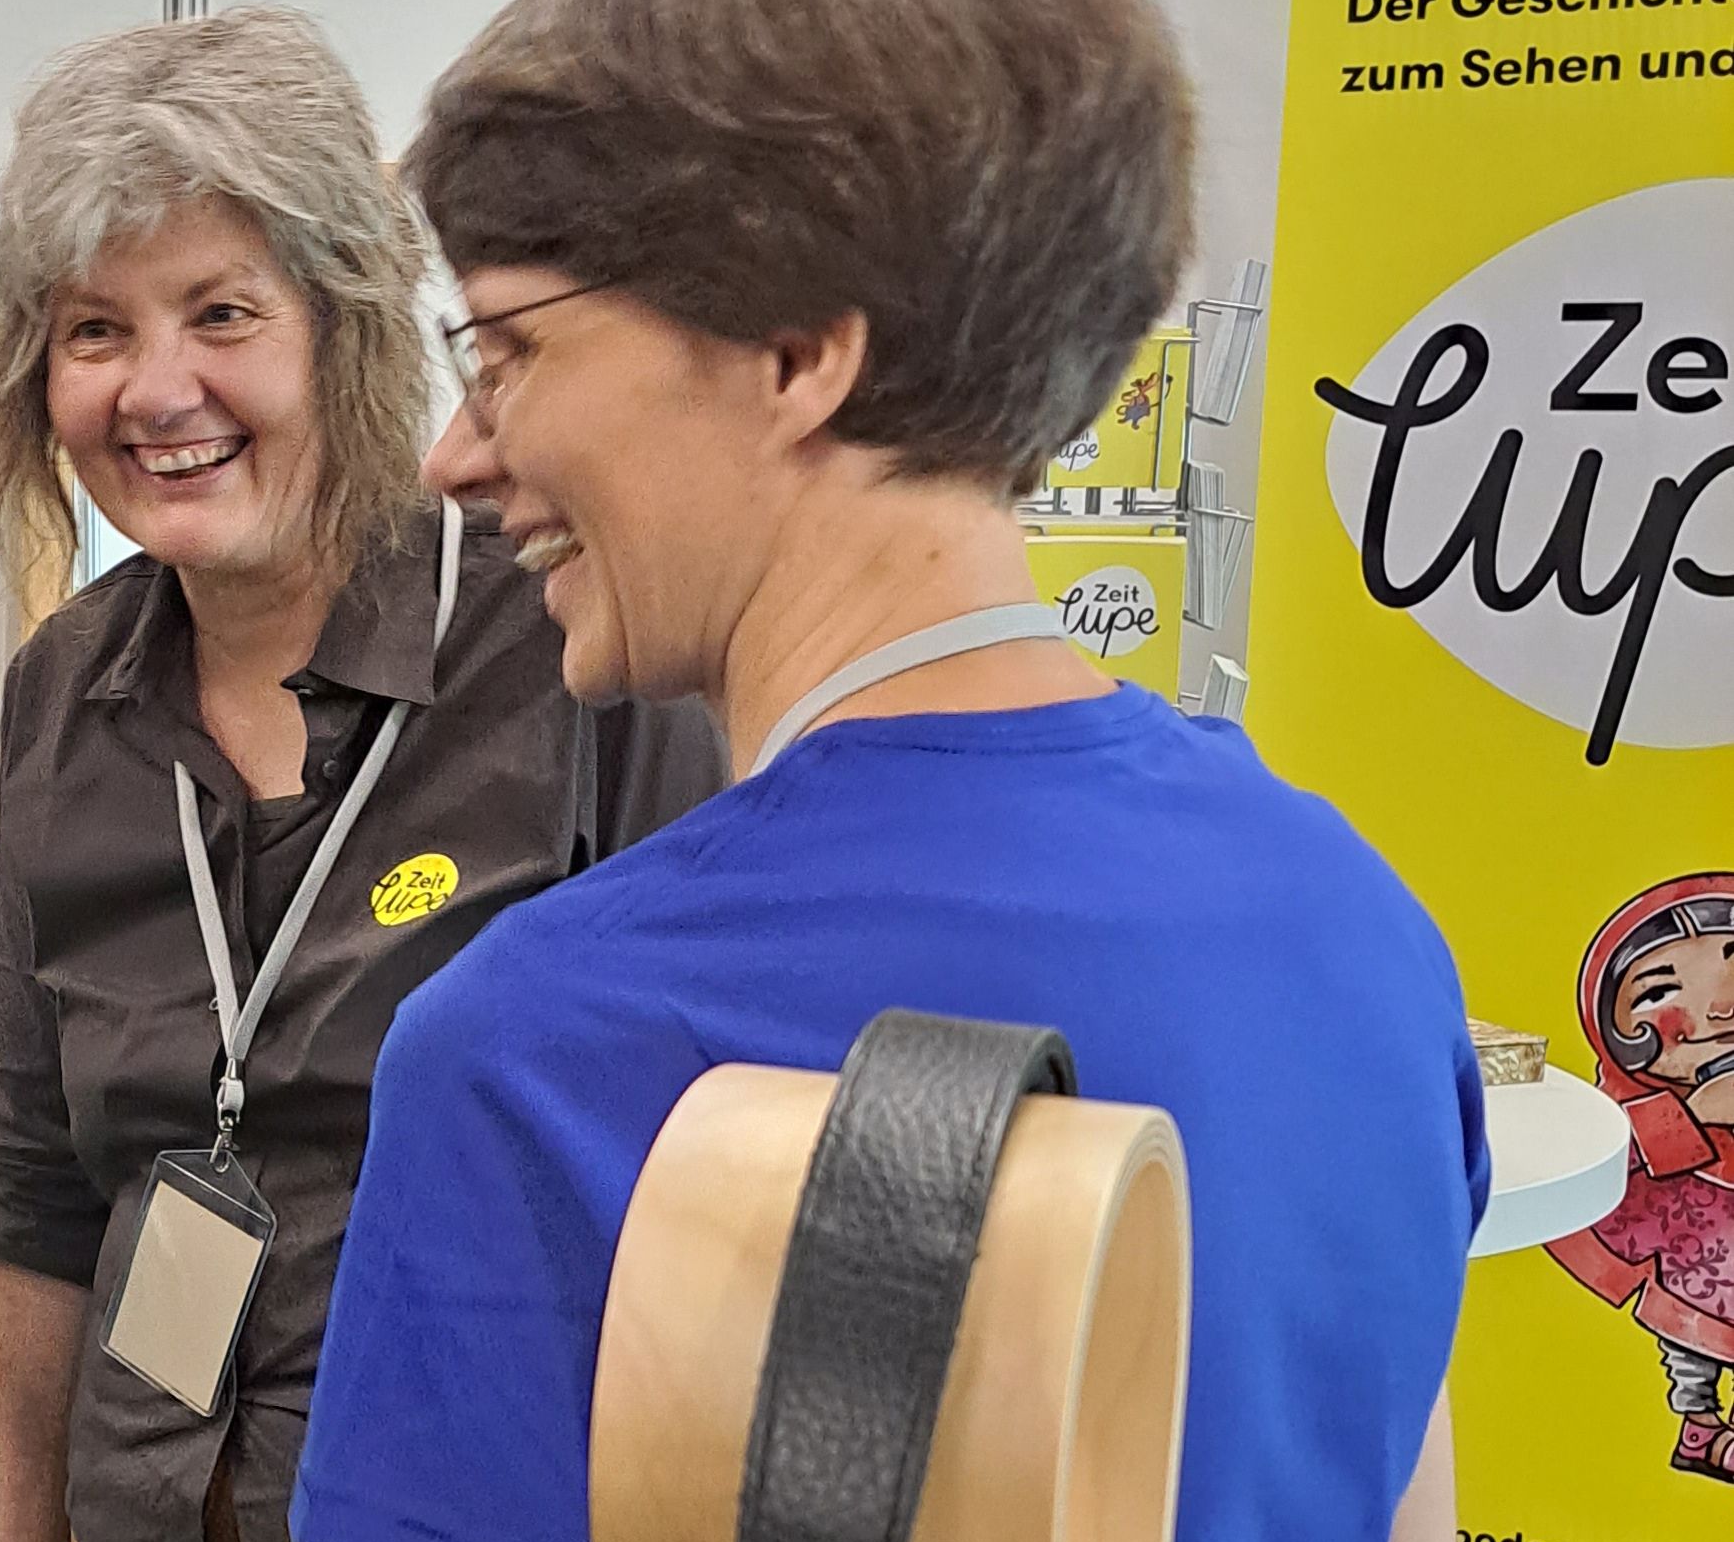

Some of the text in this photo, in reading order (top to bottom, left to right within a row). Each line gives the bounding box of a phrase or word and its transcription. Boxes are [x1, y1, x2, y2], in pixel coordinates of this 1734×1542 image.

[1339, 62, 1444, 93] zum
[1460, 46, 1621, 88] Sehen
[1550, 302, 1729, 414] Ze
[1054, 443, 1100, 472] upe
[1092, 584, 1140, 602] Zeit
[406, 870, 446, 890] Zeit
